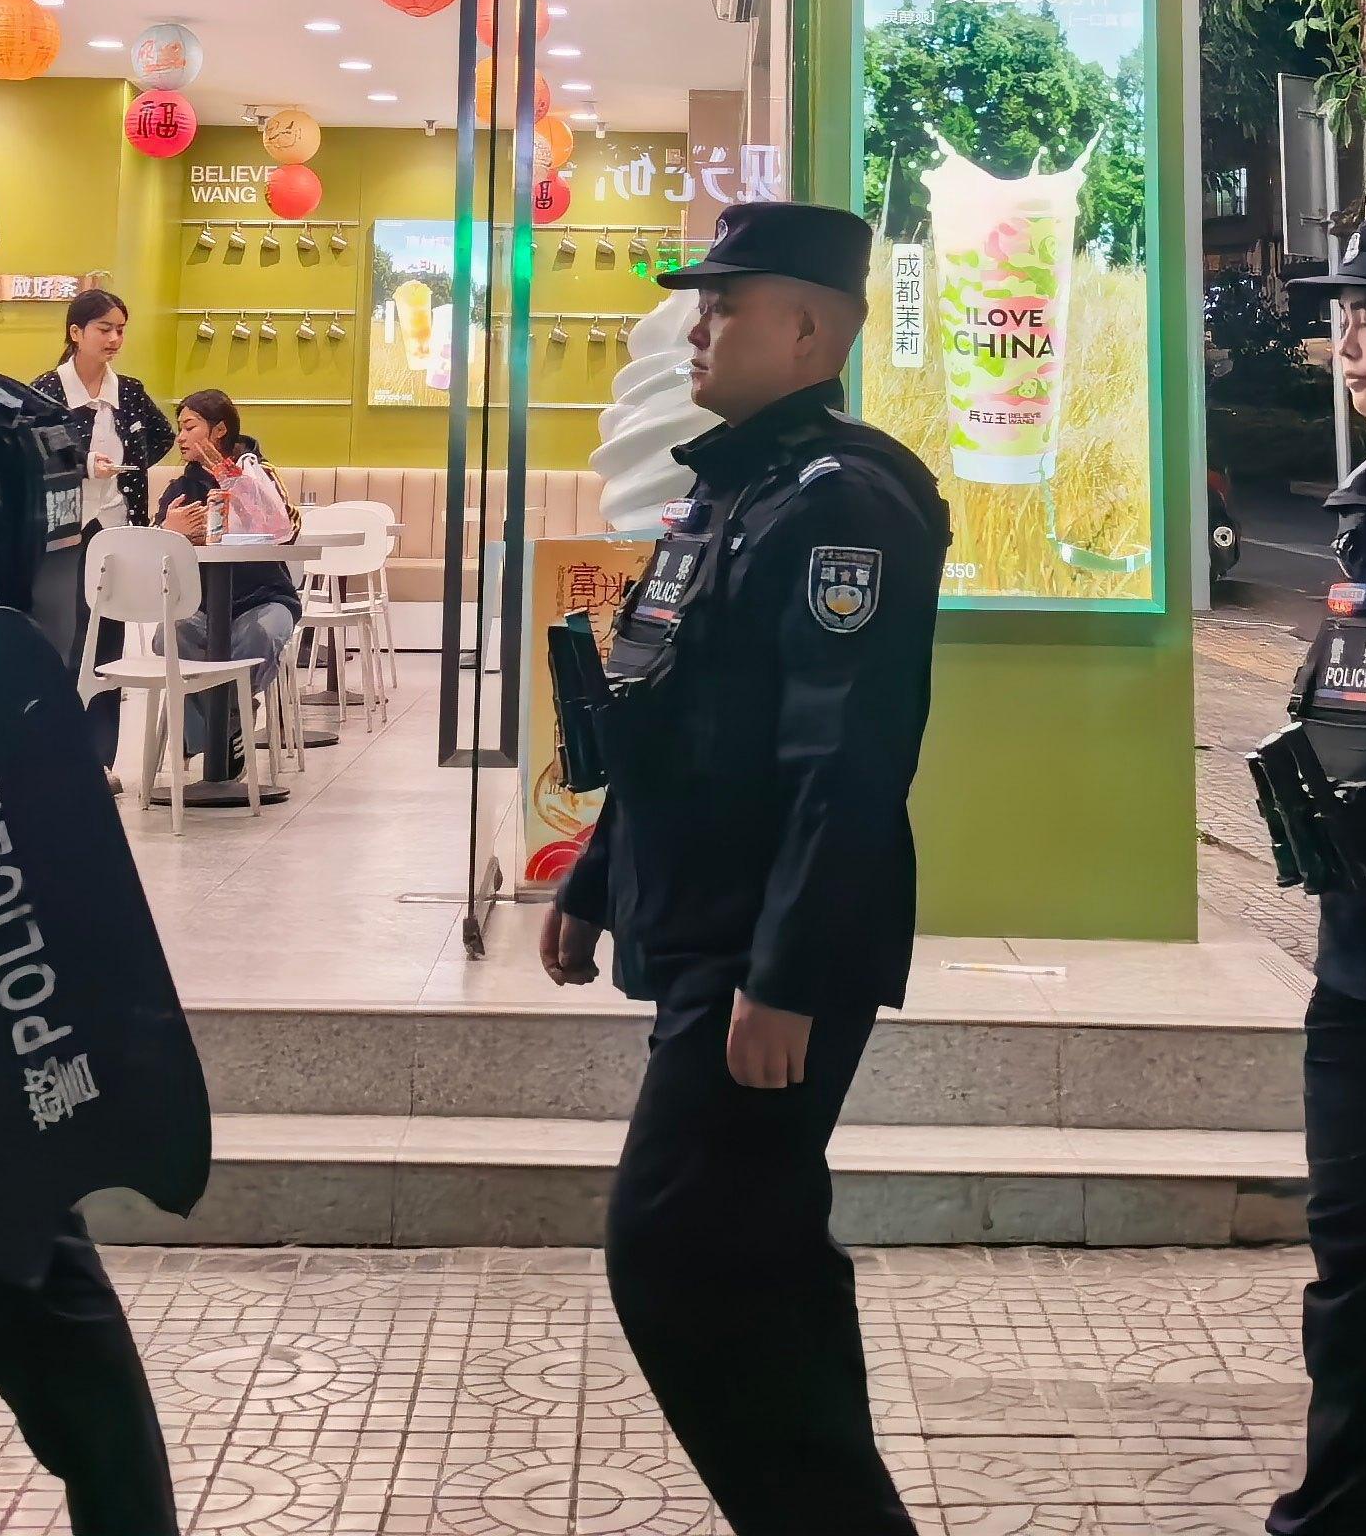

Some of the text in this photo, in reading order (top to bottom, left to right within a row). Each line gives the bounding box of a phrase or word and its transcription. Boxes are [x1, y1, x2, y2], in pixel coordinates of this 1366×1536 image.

[137, 100, 178, 139] 福
[191, 186, 257, 203] WANG
[896, 253, 921, 355] 成都茉莉
[954, 330, 1055, 359] CHINA
[645, 579, 683, 604] POLICE
